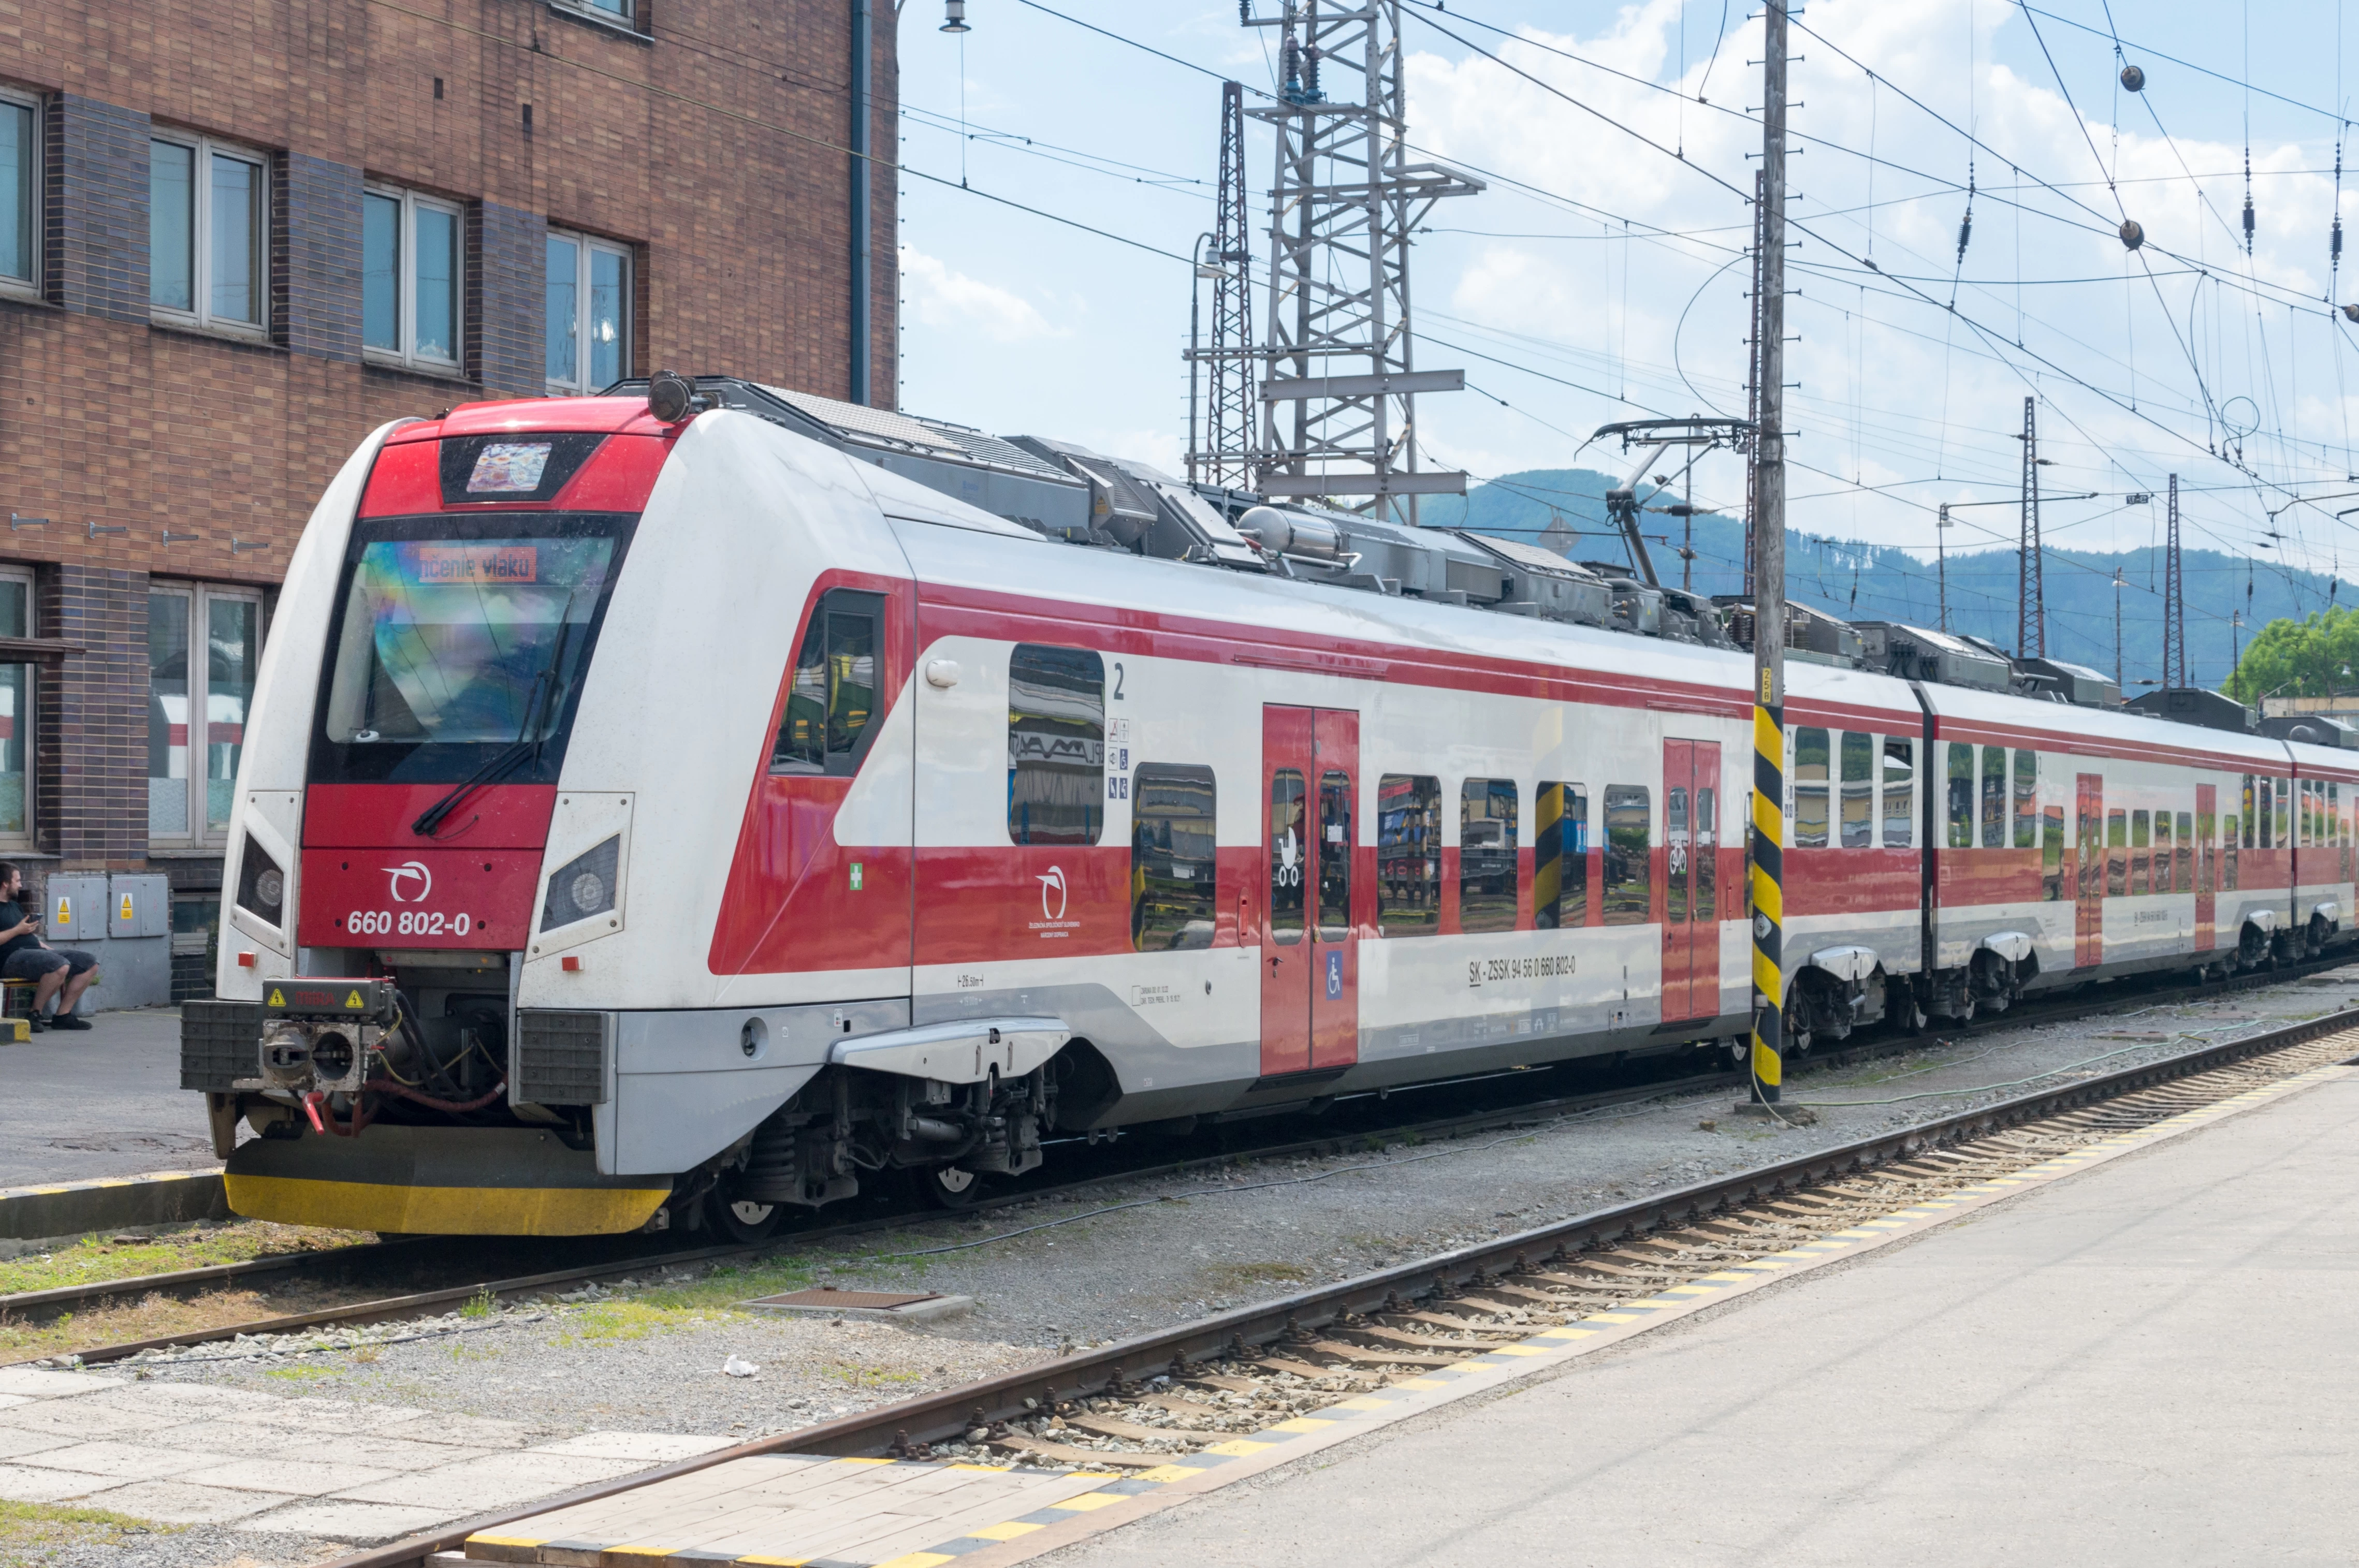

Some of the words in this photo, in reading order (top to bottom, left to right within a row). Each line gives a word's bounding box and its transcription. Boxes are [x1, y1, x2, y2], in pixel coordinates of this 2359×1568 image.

[482, 553, 529, 577] vlaku
[1114, 662, 1124, 700] 2
[1787, 730, 1792, 755] 2
[347, 911, 392, 934] 660
[398, 912, 470, 936] 802-0
[1469, 961, 1481, 983] SK
[1488, 959, 1510, 980] ZSSK
[1512, 959, 1521, 978] 94
[1523, 958, 1533, 978] 56
[1534, 958, 1539, 977] 0
[1541, 957, 1554, 976] 660
[1556, 955, 1576, 975] 802-0
